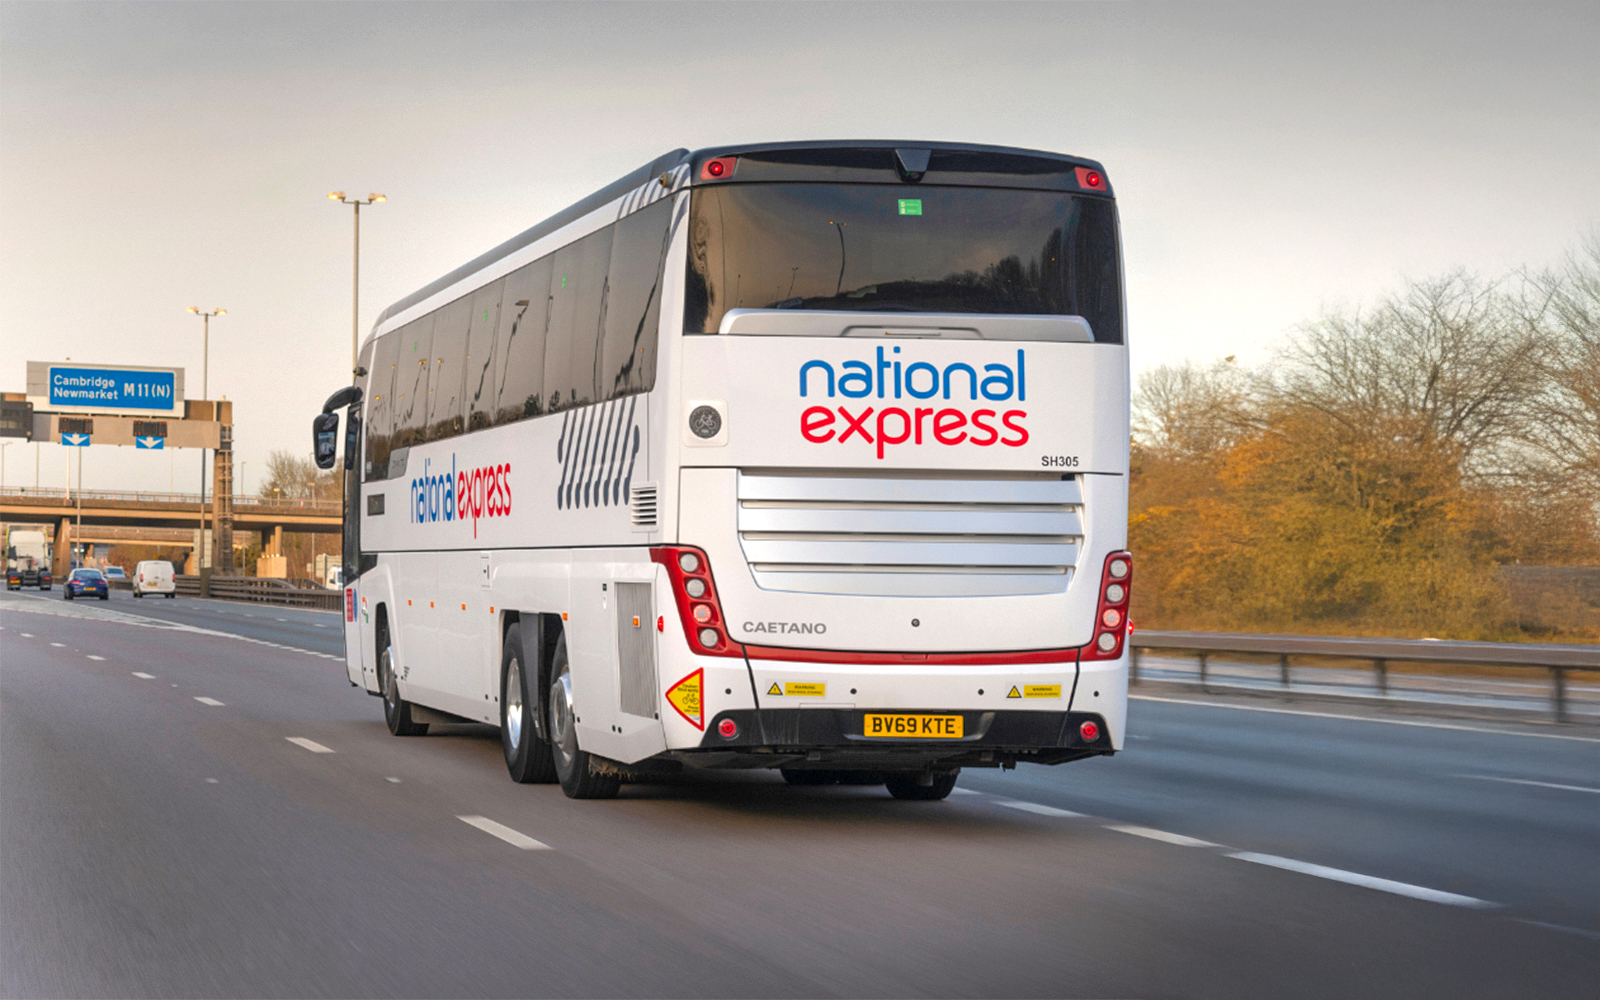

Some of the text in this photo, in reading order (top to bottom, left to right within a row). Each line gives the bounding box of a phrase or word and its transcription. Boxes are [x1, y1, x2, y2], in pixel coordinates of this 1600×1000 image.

[54, 374, 115, 389] Cambridge
[799, 345, 1026, 402] national
[54, 387, 118, 400] Newmarket
[800, 405, 1029, 459] express
[1041, 455, 1079, 468] SH305
[411, 453, 511, 539] national express
[742, 621, 827, 635] CAETANO
[872, 716, 956, 734] BV69 KTE
